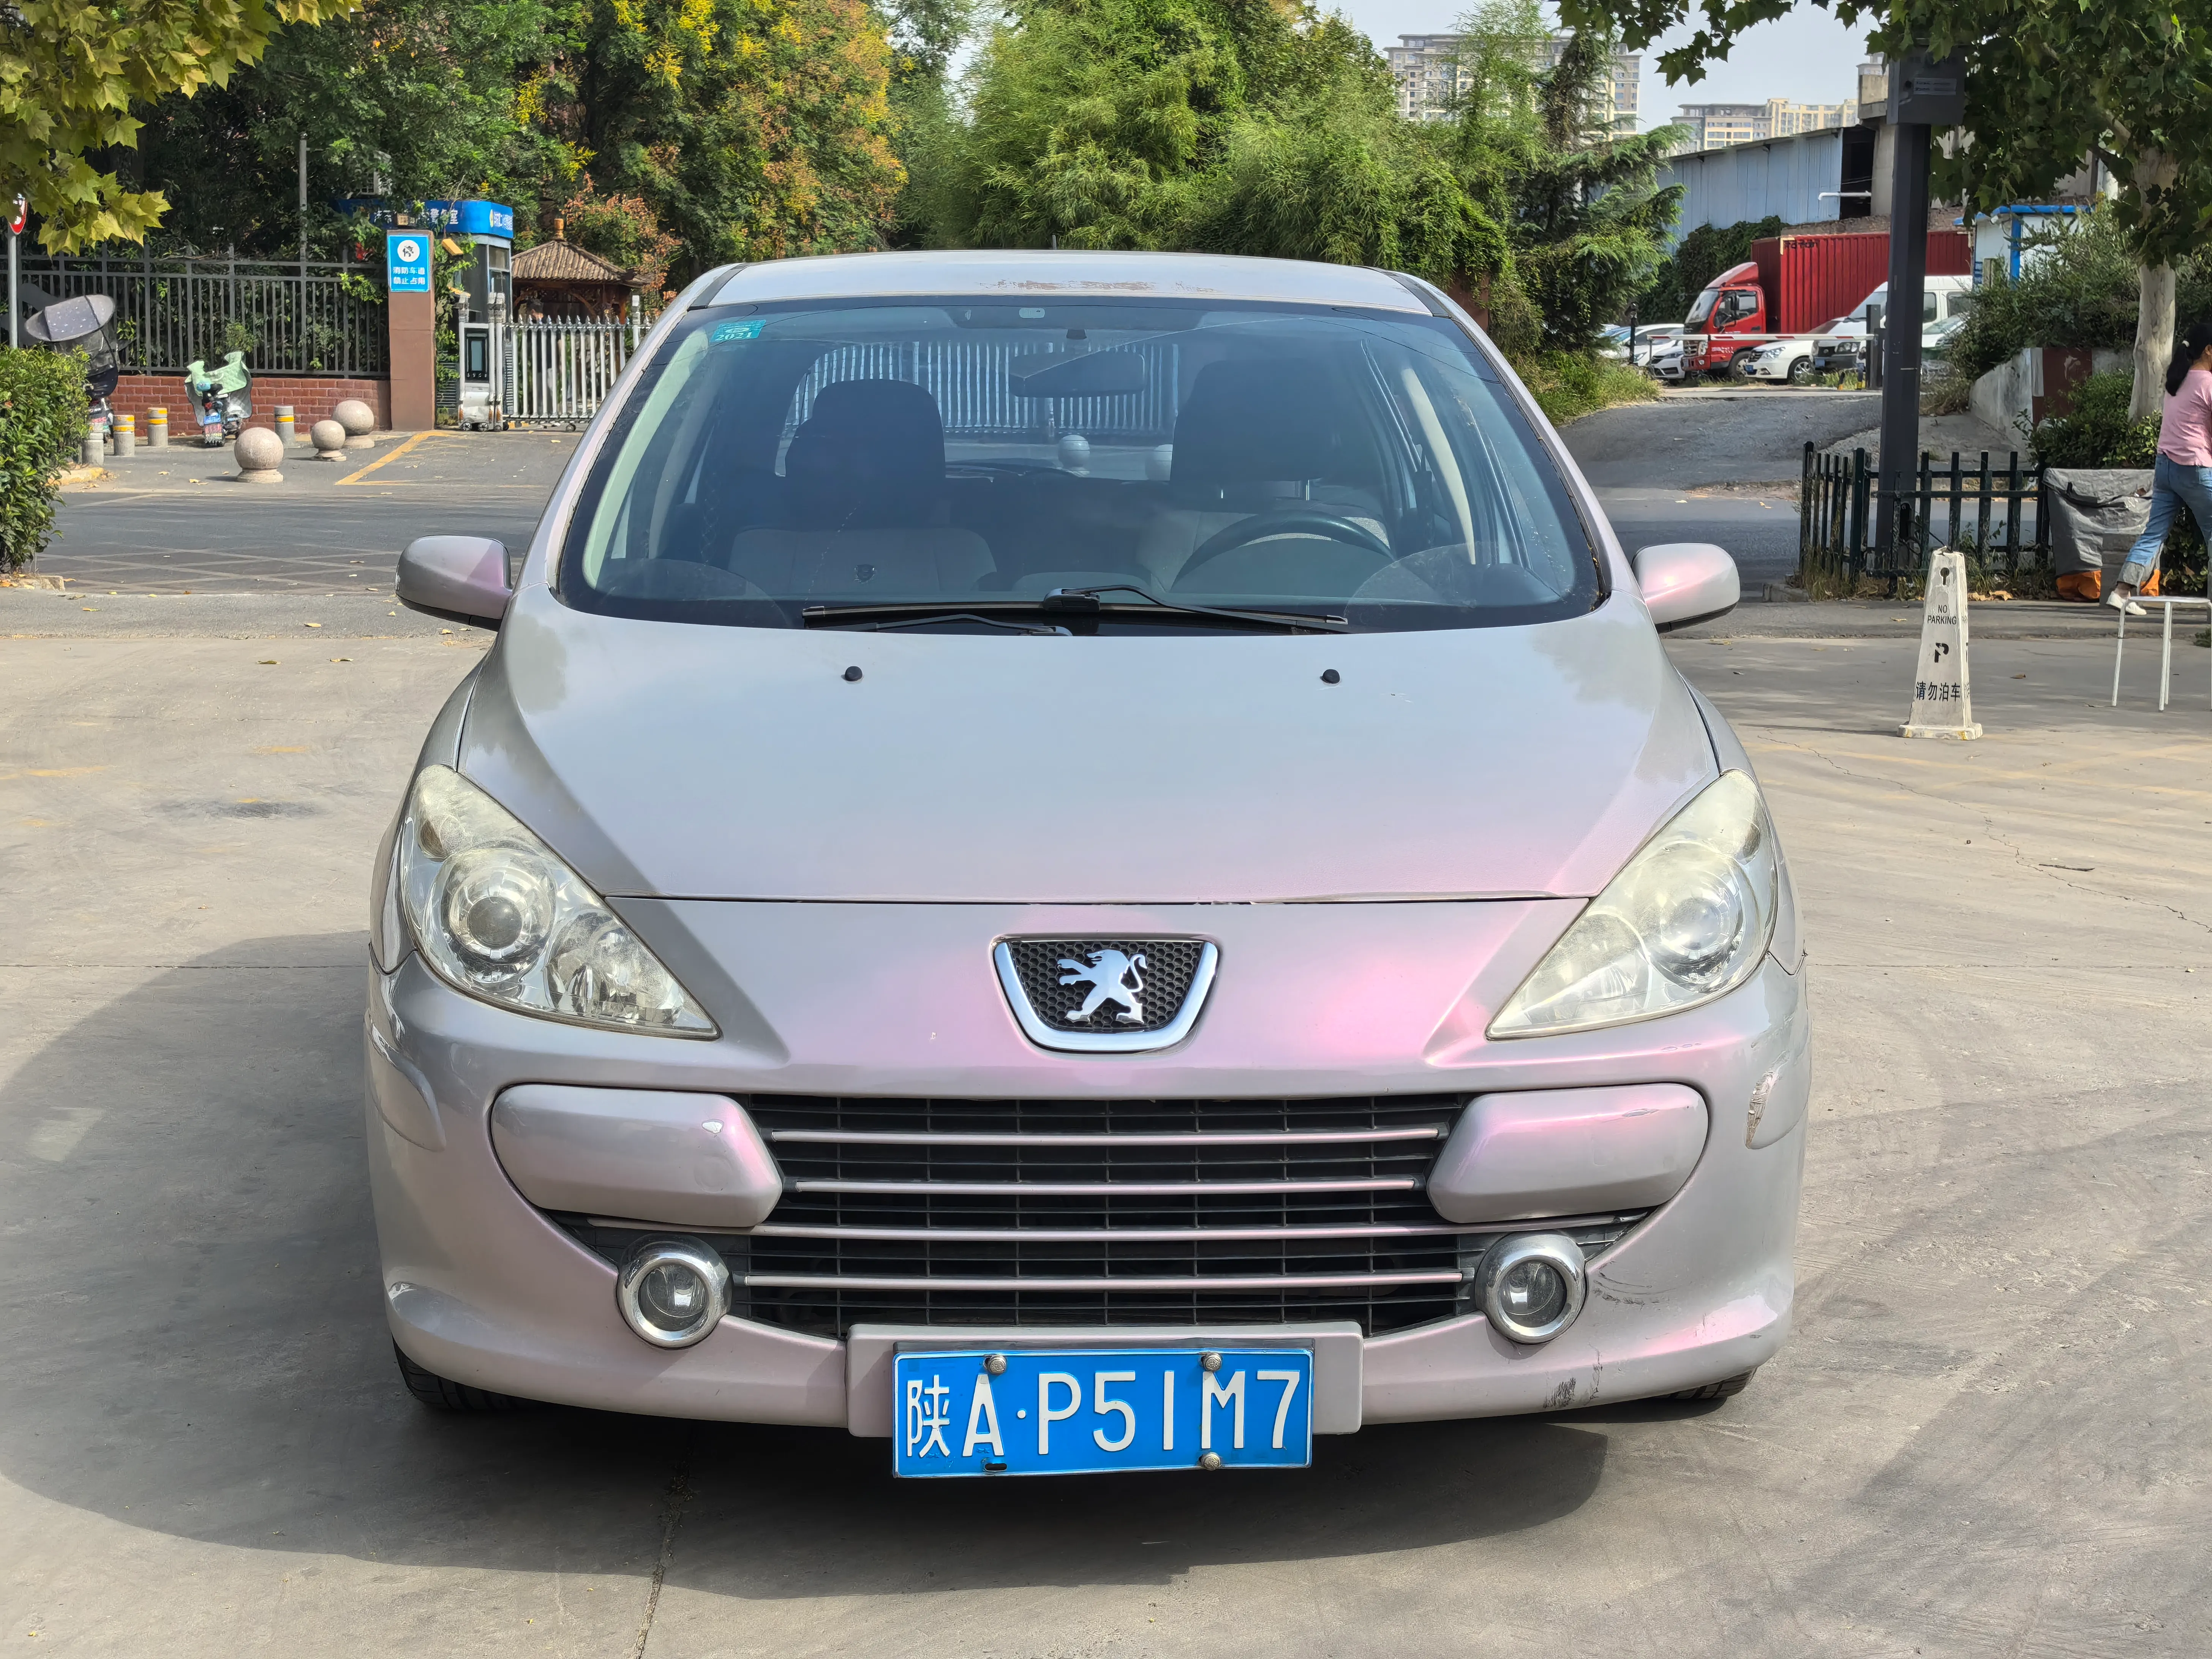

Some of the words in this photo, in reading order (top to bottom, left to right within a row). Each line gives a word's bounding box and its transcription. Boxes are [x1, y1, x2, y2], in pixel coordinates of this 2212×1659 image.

[714, 332, 752, 341] 2021
[1937, 604, 1948, 613] NO
[1927, 615, 1957, 625] PARKING
[1916, 681, 1961, 702] 请勿泊车
